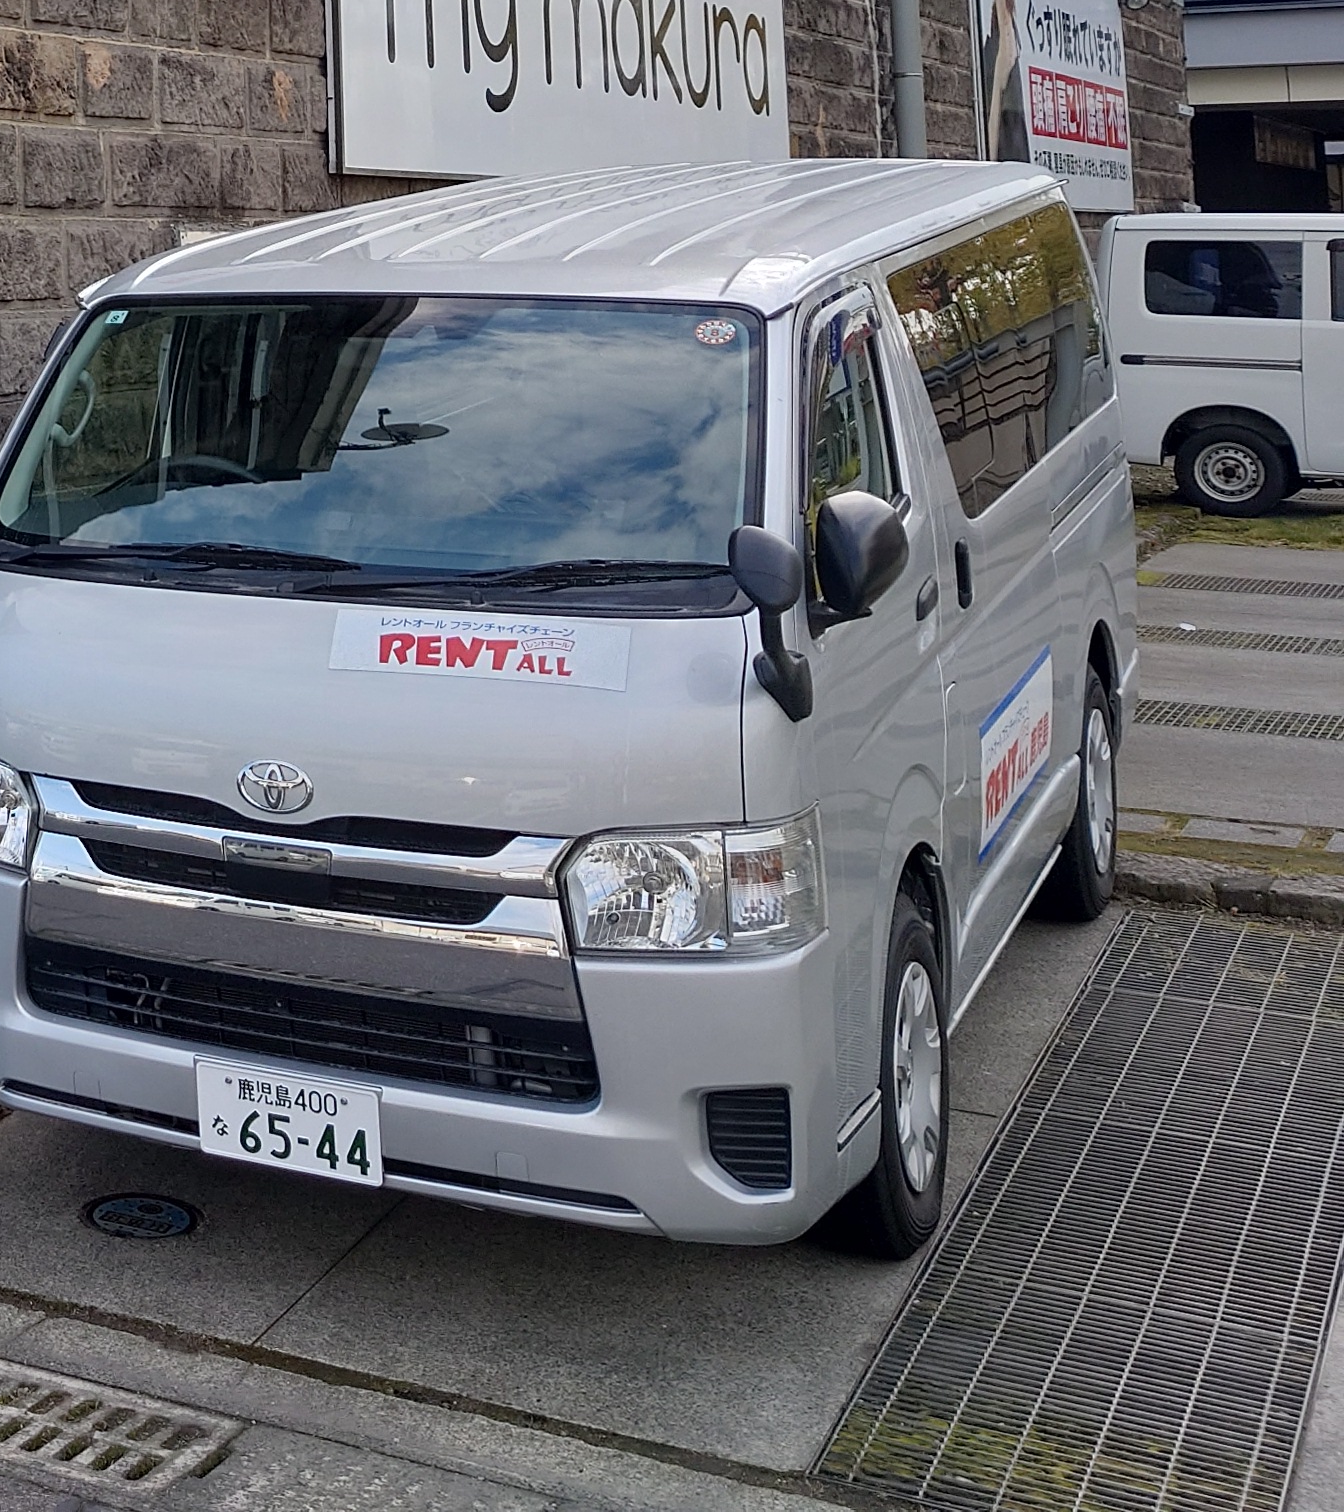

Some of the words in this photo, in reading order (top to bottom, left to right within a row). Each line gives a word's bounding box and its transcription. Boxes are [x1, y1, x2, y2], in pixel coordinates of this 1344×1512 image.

[381, 617, 447, 630] レントオール
[450, 620, 574, 637] フランチャイズチェーン
[212, 1114, 229, 1137] な
[240, 1110, 370, 1176] 65-44
